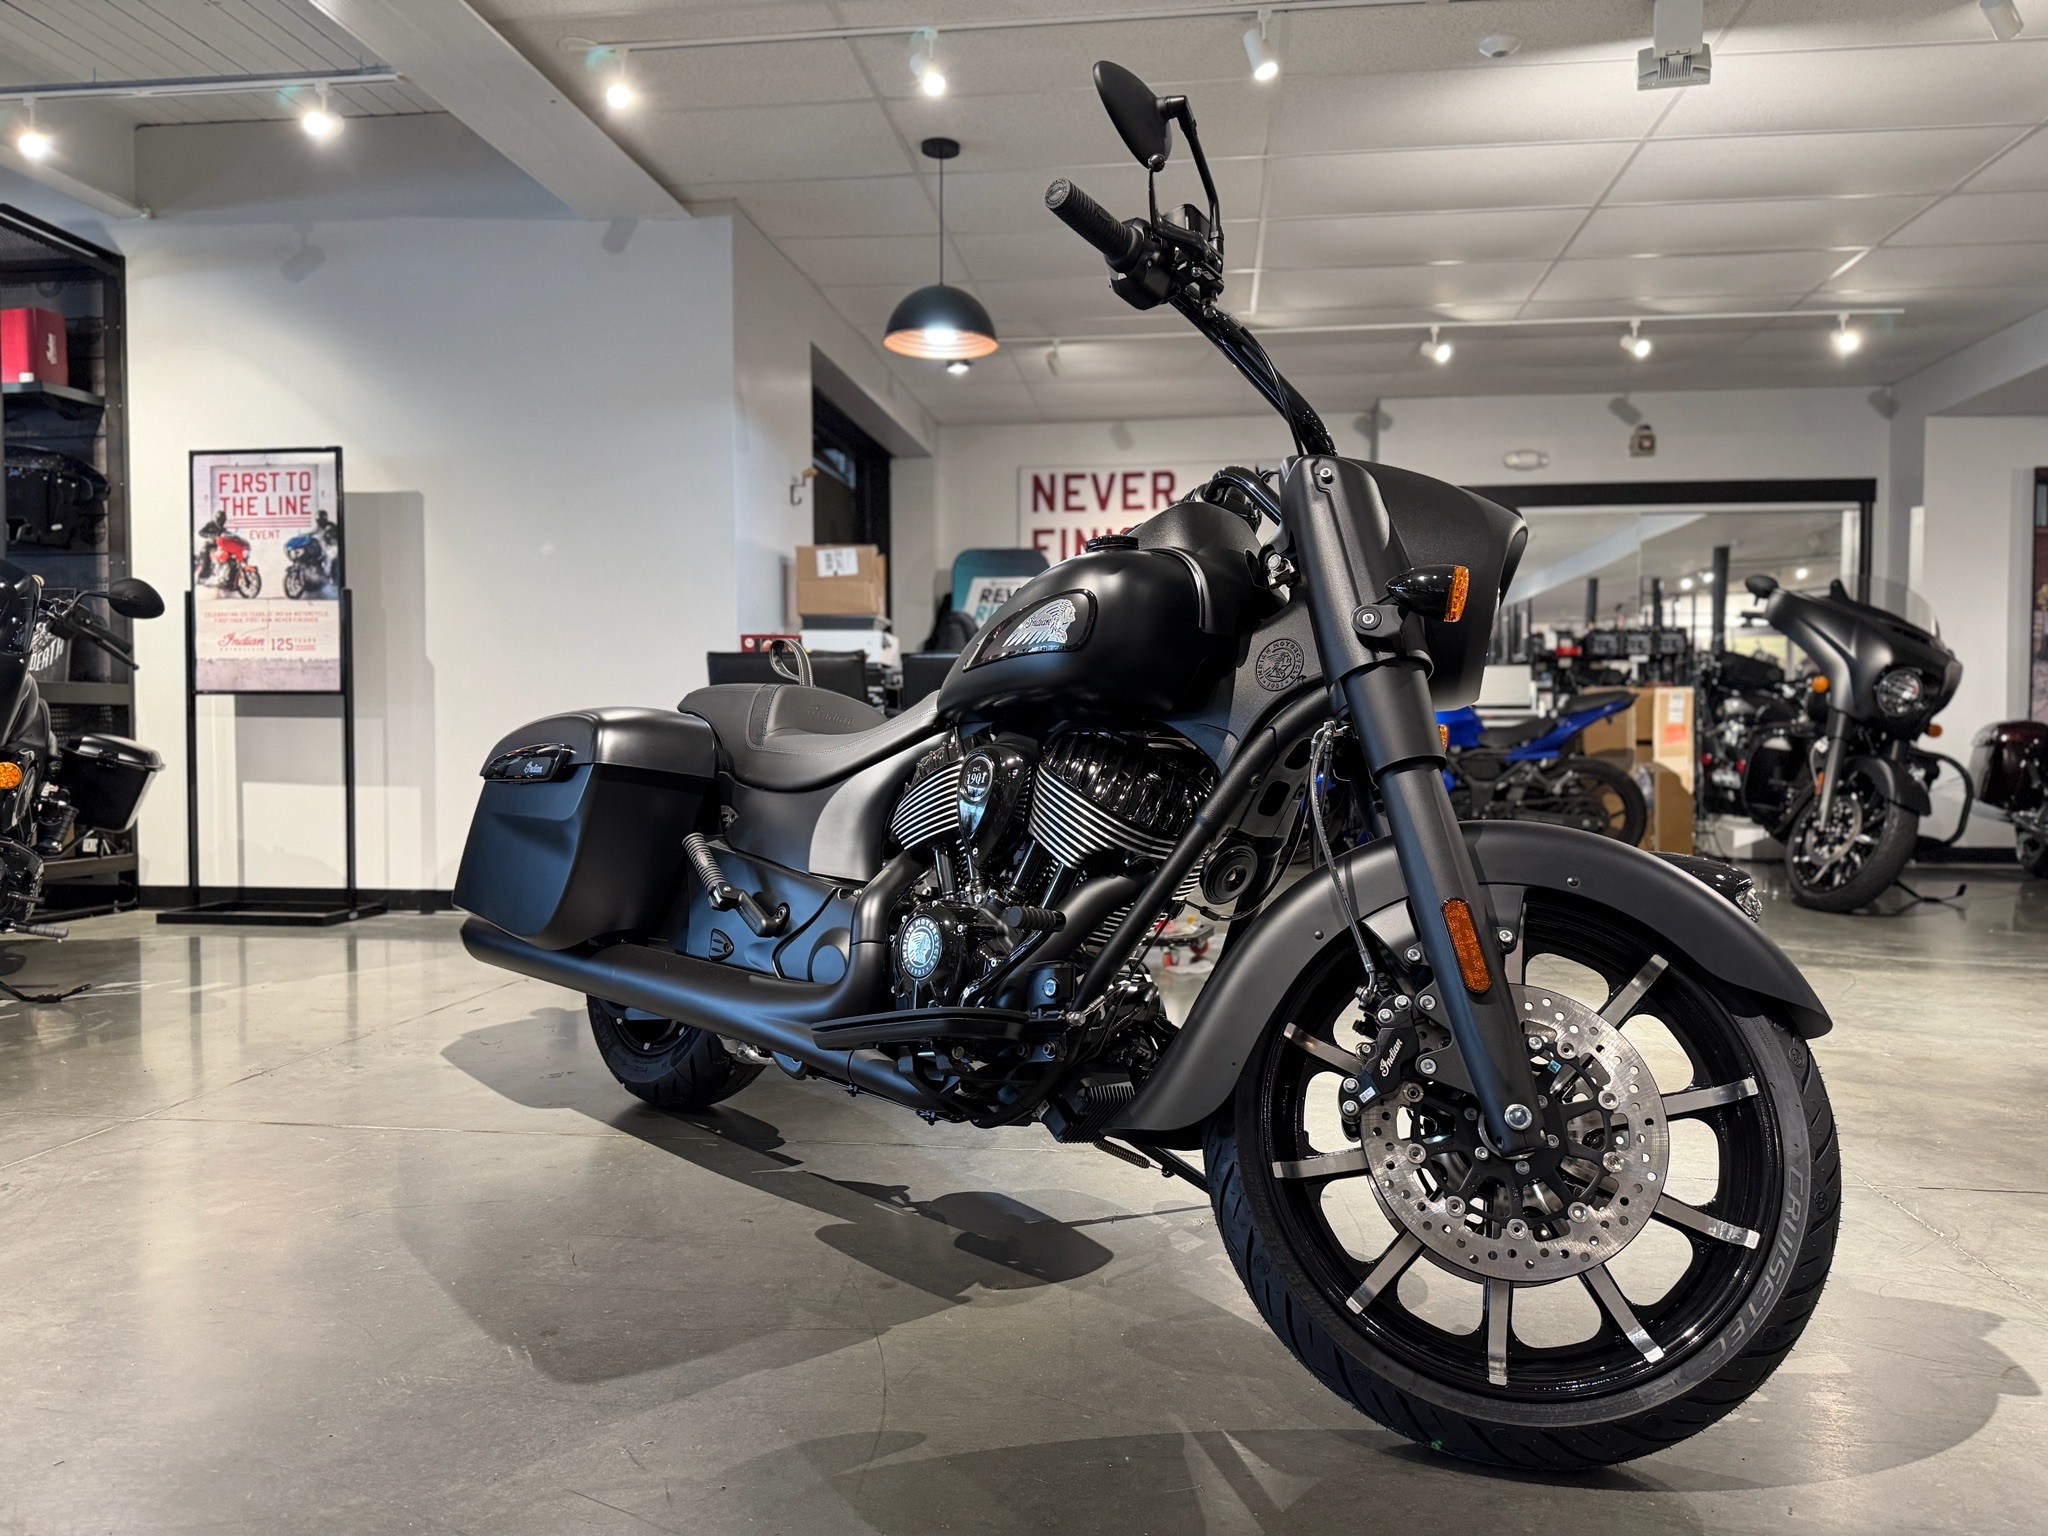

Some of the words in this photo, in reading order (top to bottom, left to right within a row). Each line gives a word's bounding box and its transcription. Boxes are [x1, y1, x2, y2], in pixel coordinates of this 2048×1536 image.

[285, 471, 311, 492] TO
[1032, 471, 1175, 512] NEVER
[219, 496, 258, 516] THE
[265, 495, 311, 515] LINE
[249, 529, 279, 540] EVENT
[218, 632, 265, 647] Indian
[271, 637, 294, 652] 125
[28, 637, 65, 672] DEATH
[966, 771, 988, 785] 1901
[1379, 1038, 1403, 1077] Indian
